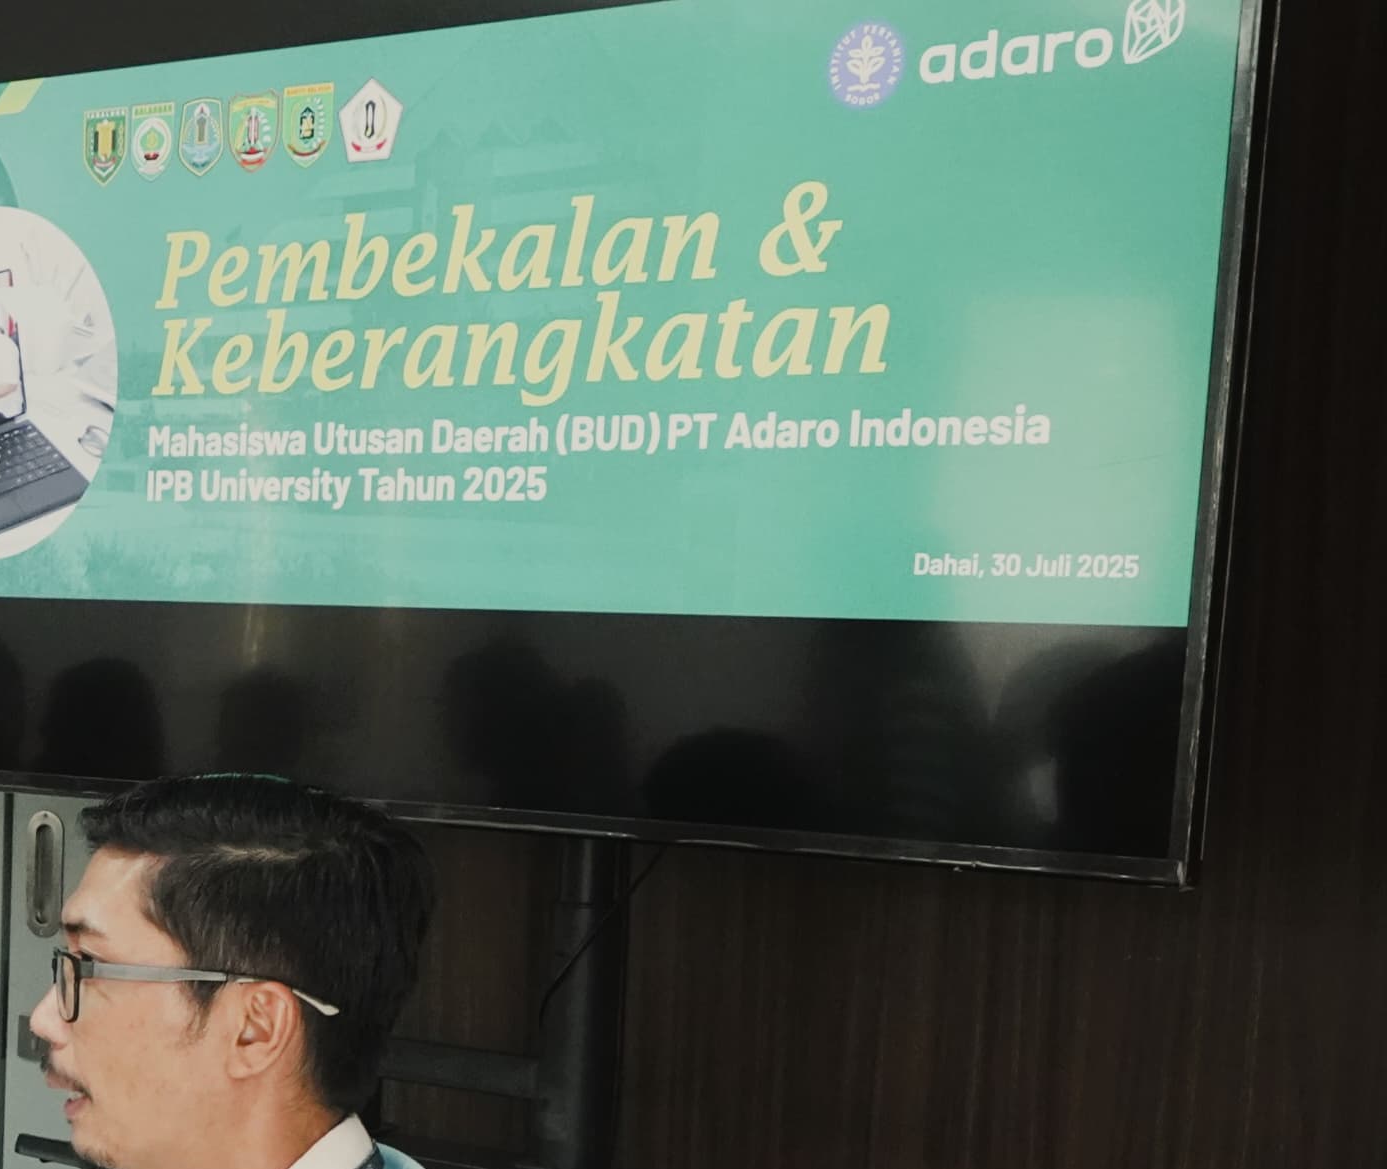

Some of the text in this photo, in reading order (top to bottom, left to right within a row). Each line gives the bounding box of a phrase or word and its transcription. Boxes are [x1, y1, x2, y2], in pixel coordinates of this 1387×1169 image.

[919, 29, 1114, 84] adaro
[155, 180, 842, 309] Pembekalan &
[151, 292, 891, 406] Keberangkatan
[148, 404, 1051, 457] Mahasiswa Utusan Daerah (BUD) PT Adaro Indonesia
[146, 466, 548, 510] IPB University Tahun 2025
[913, 552, 1140, 579] Dahai, 30 Juli 2025
